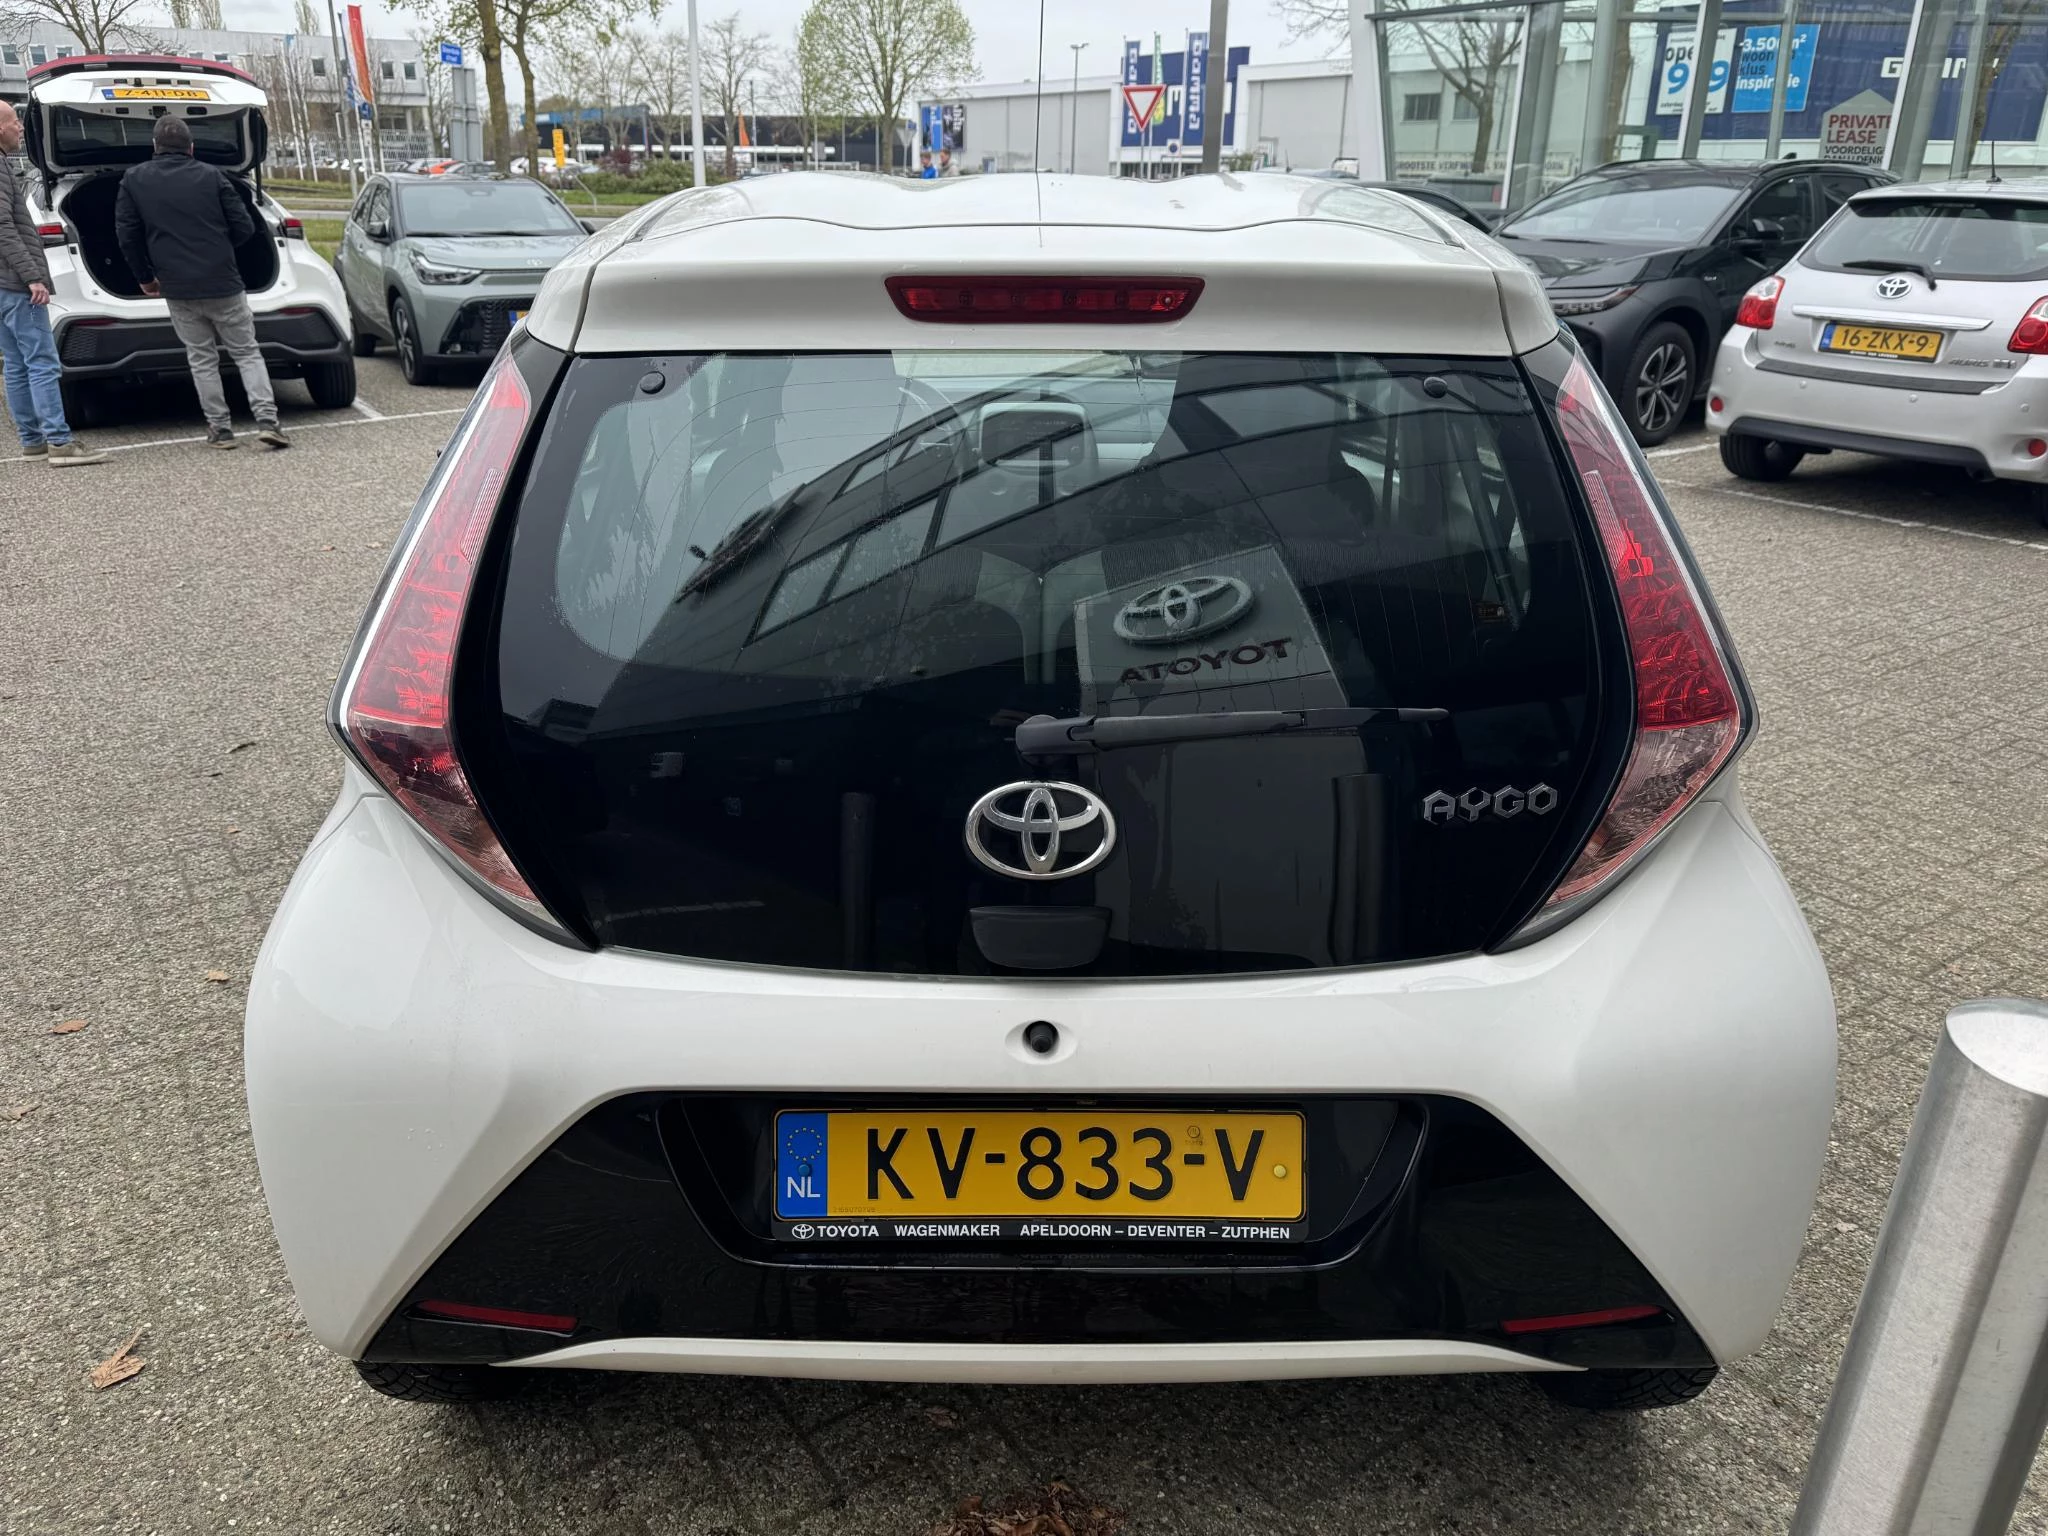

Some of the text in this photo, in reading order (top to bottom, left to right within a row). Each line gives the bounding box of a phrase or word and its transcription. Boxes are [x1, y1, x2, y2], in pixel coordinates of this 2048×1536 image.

[1739, 62, 1766, 75] klus
[1827, 130, 1877, 144] LEASE
[1841, 328, 1930, 353] 16-ZKX-9
[1422, 782, 1558, 825] AYGO
[866, 1126, 1265, 1201] KV-833-V
[786, 1176, 821, 1199] NL
[816, 1225, 880, 1238] TOYOTA
[894, 1224, 1000, 1237] WAGENMAKER
[1019, 1224, 1111, 1238] APELDOORN
[1127, 1225, 1206, 1239] DEVENTER
[1221, 1226, 1290, 1239] ZUTPHEN
